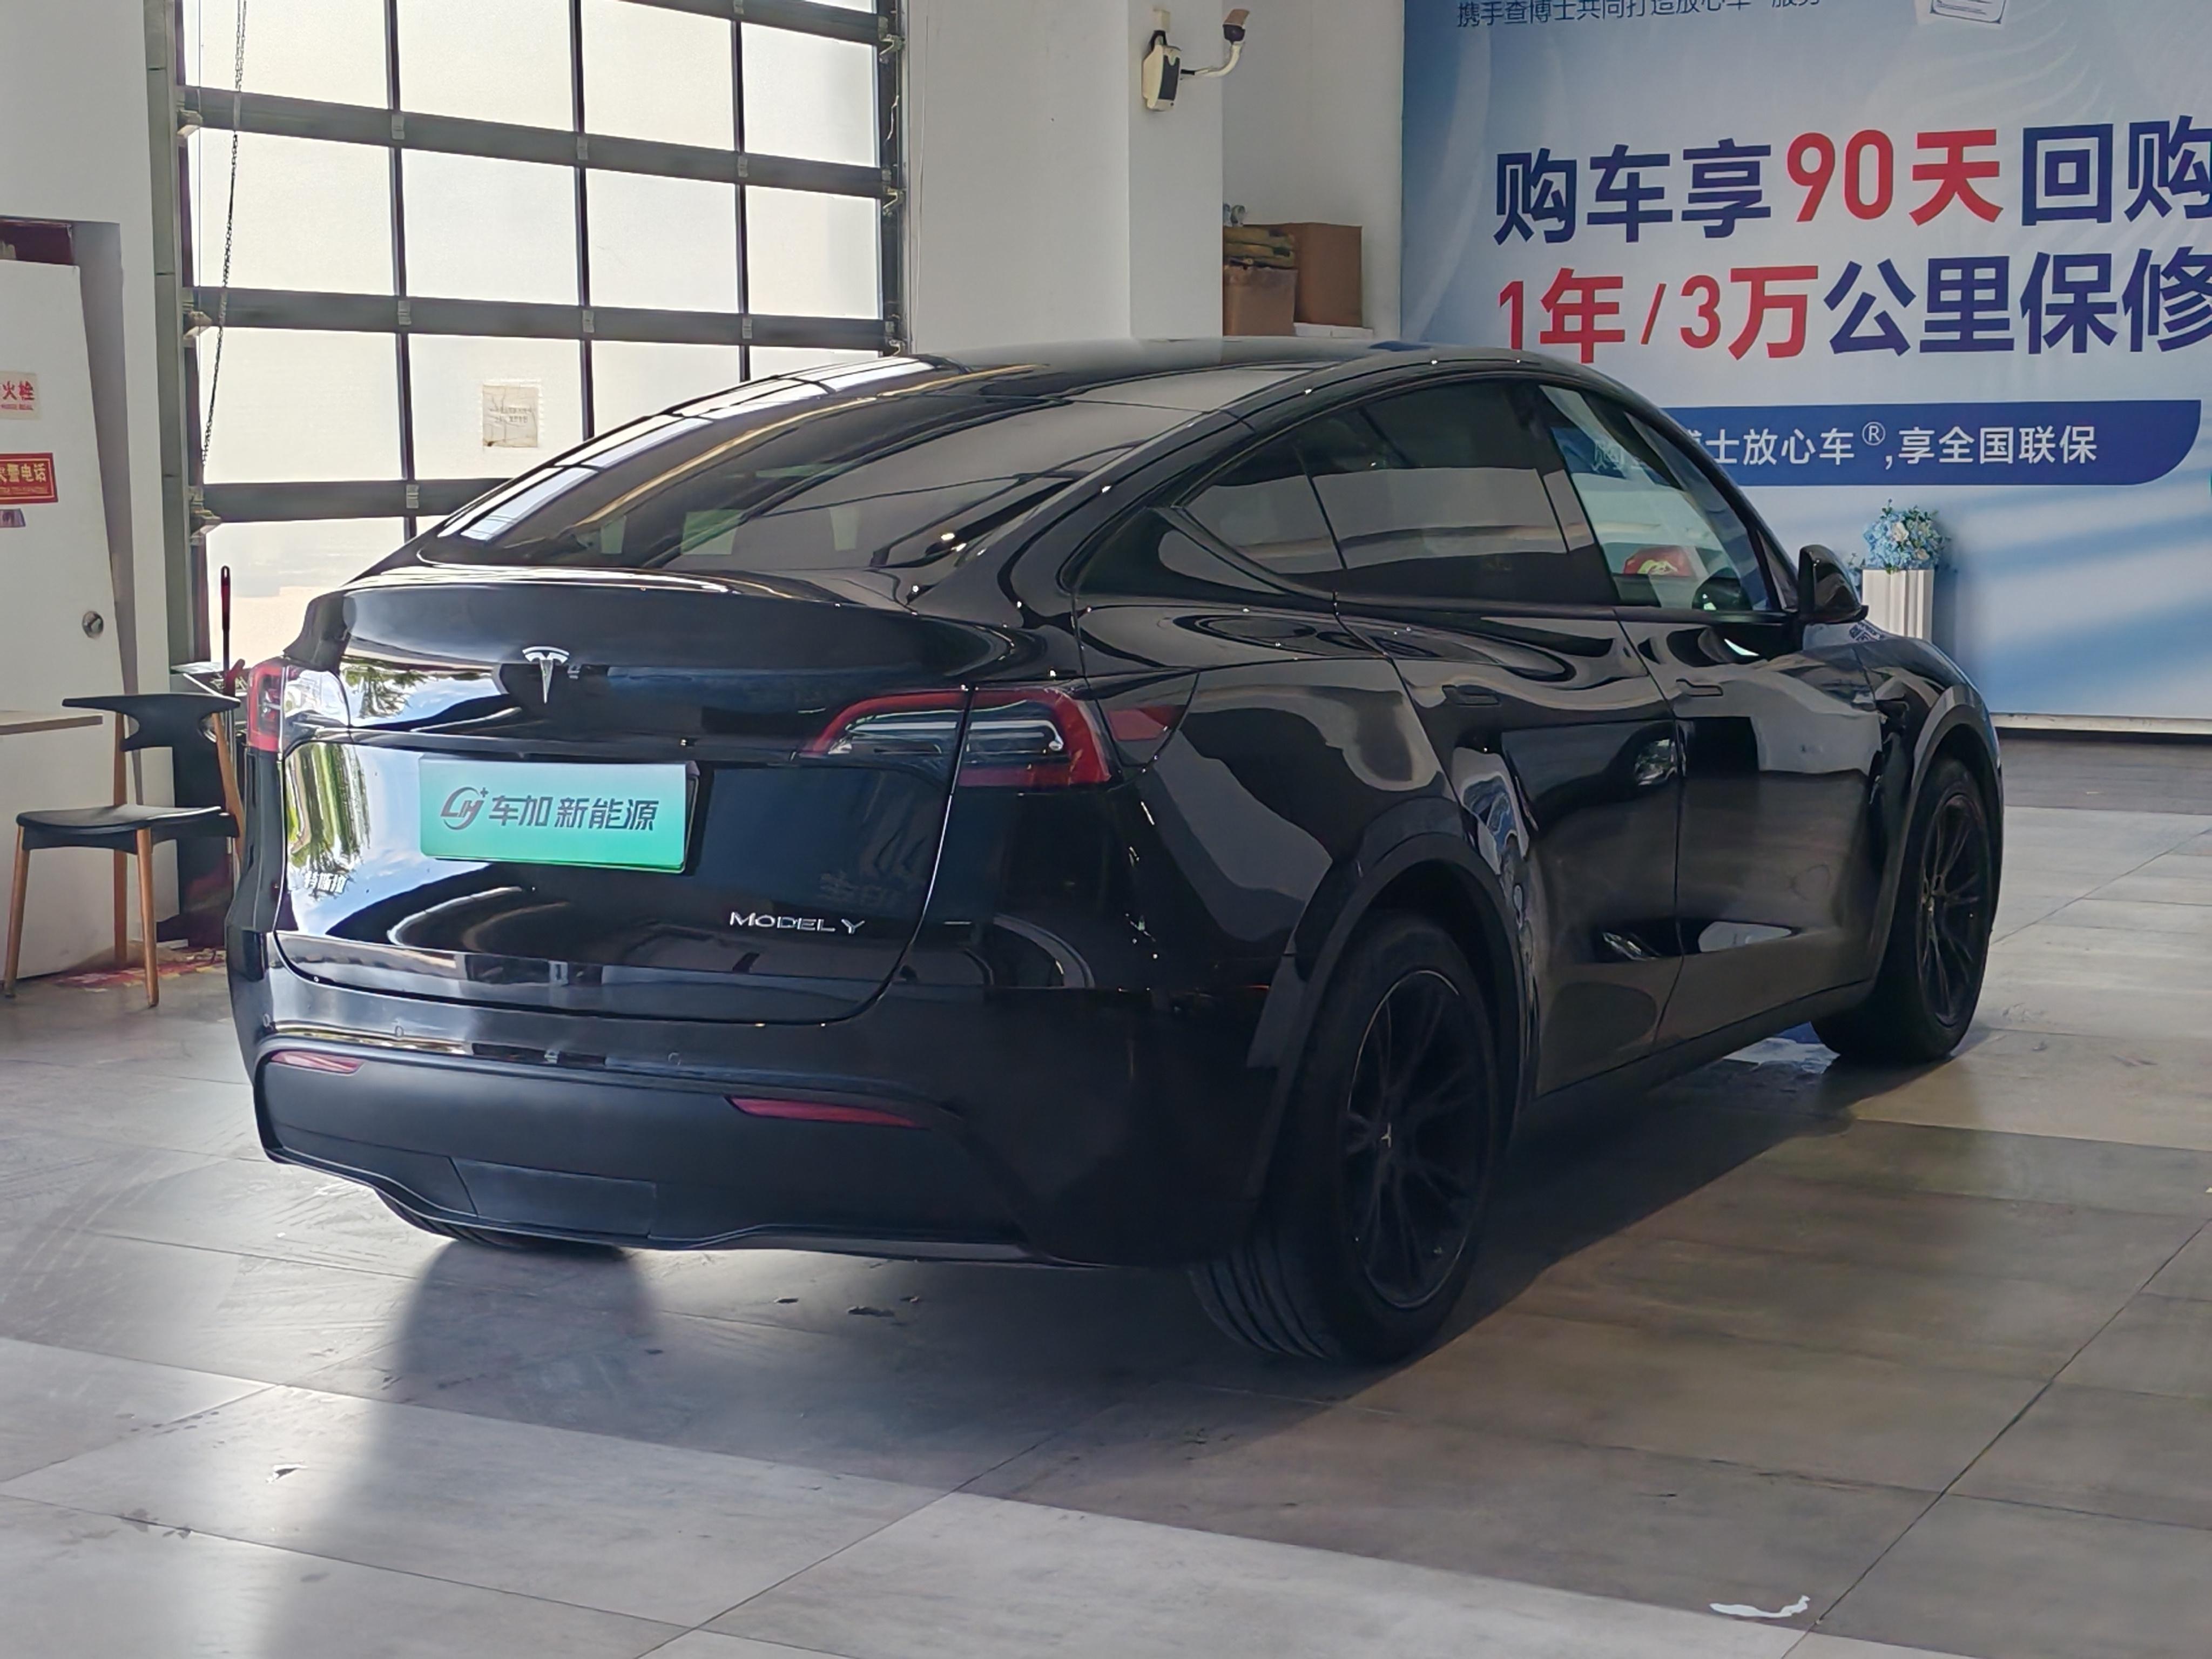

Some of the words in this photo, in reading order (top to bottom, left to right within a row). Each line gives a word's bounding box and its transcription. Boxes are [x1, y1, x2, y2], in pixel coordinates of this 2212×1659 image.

[1494, 115, 2212, 245] 购车享90天回购
[1498, 246, 2212, 363] 1年/3万公里保修
[1684, 421, 2097, 470] 士放心车®,享全国联保
[489, 795, 659, 831] 车加新能源
[729, 912, 835, 932] MODEL
[841, 919, 865, 934] Y
